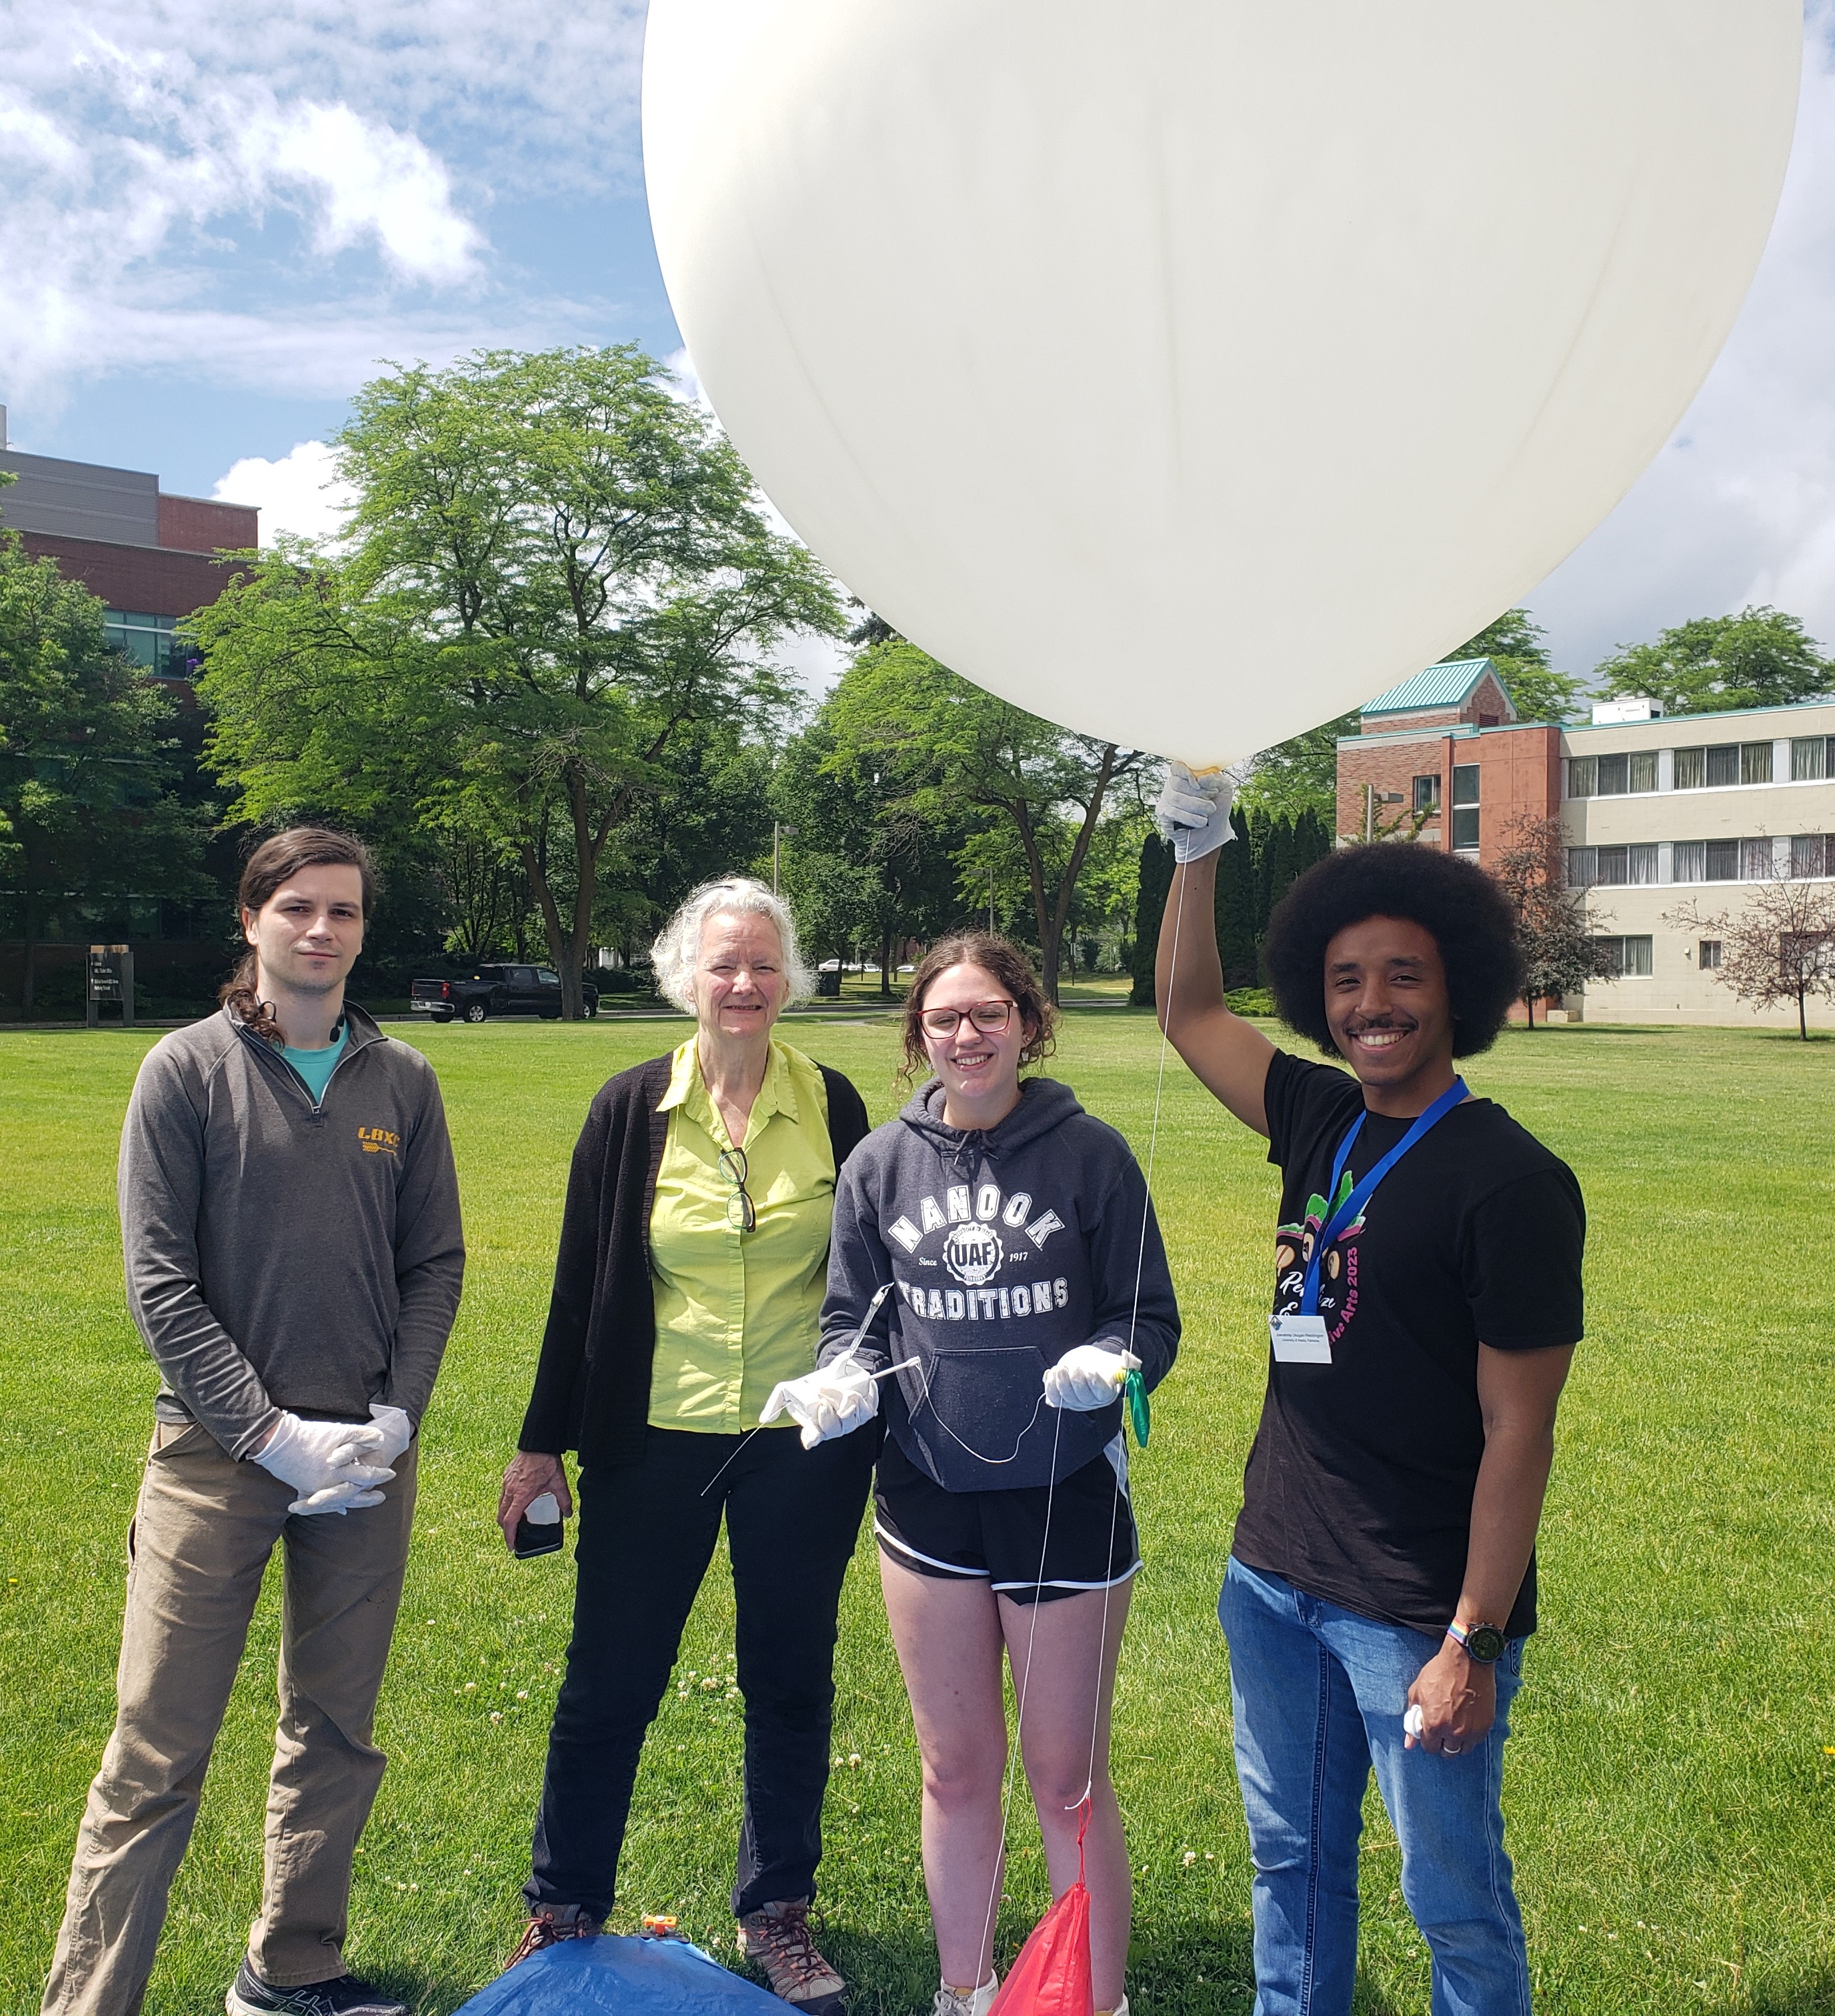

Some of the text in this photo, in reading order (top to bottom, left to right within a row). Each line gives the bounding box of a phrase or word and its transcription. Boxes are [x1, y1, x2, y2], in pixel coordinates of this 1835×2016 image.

[887, 1184, 1066, 1253] NANOOK
[918, 1252, 1028, 1266] Since 1917
[954, 1242, 992, 1267] UAF
[897, 1278, 1068, 1320] TRADITIONS
[1328, 1246, 1358, 1346] ive Arts 2023
